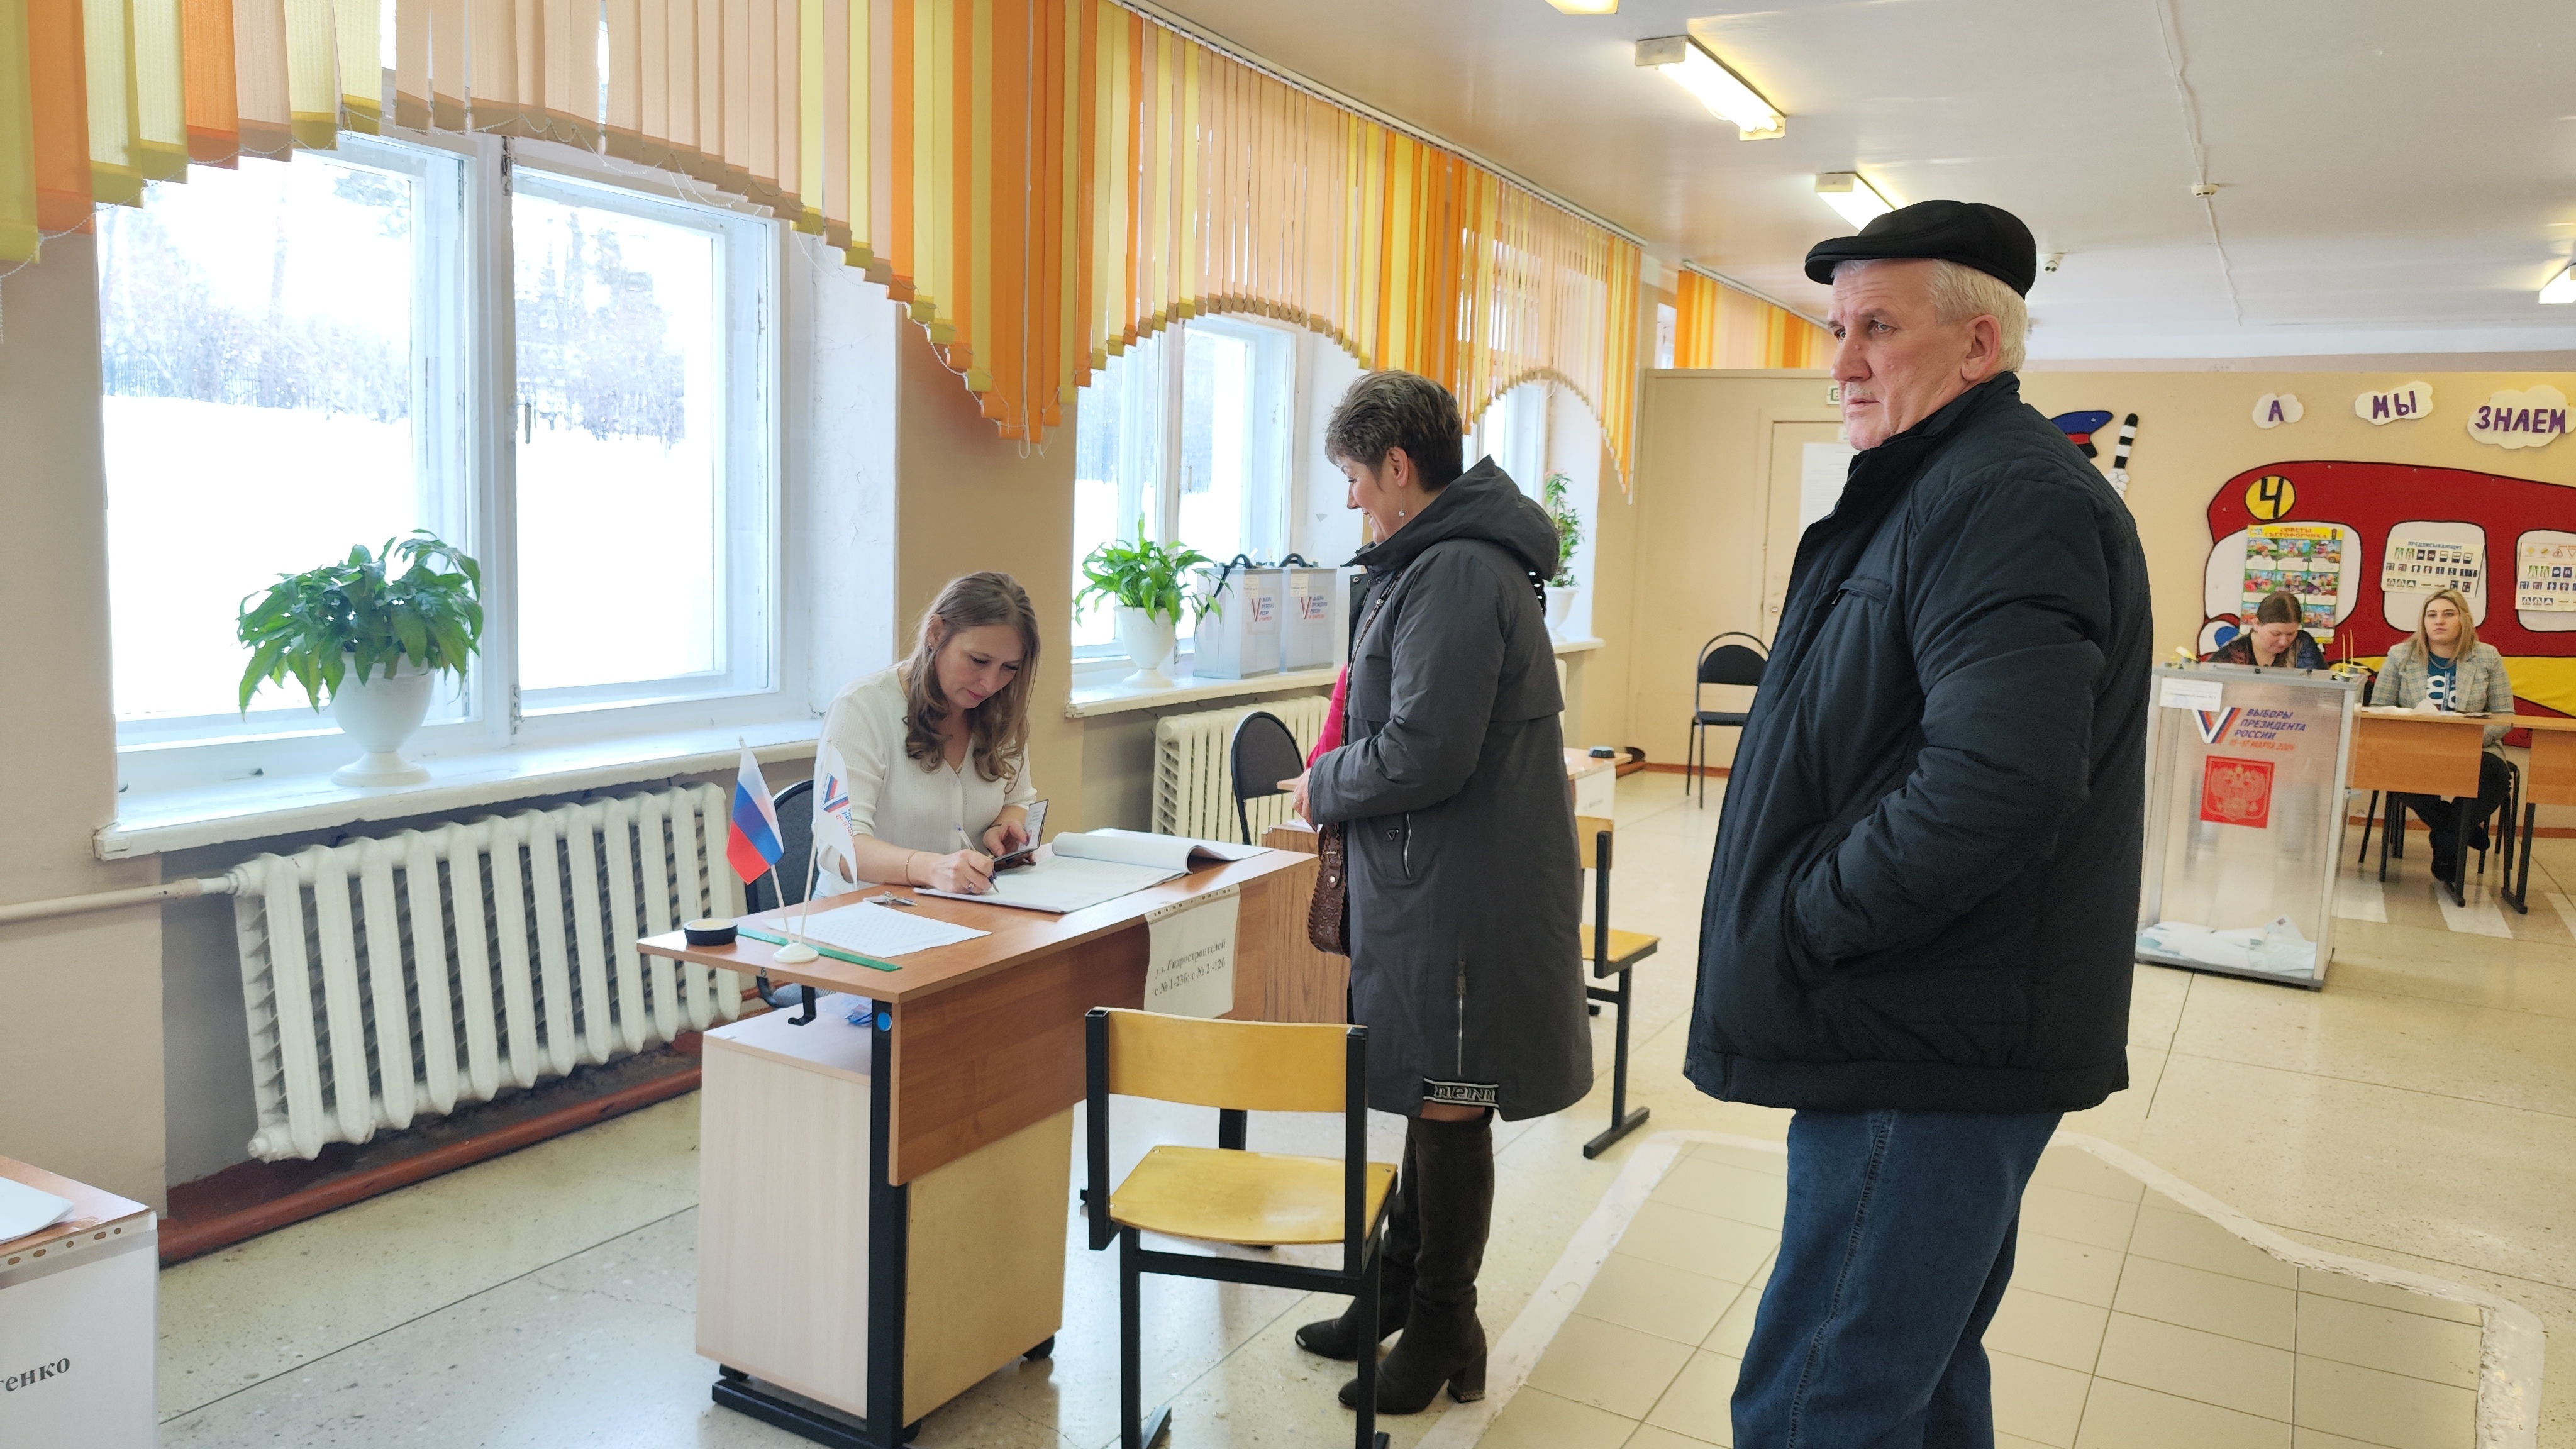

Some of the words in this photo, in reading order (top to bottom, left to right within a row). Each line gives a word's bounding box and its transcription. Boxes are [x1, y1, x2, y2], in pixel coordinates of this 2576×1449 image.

[2268, 400, 2284, 421] А
[2373, 390, 2417, 419] МЫ
[2475, 406, 2567, 434] ЗНАЕМ
[2407, 541, 2462, 550] ПРЕДПИСЫВАЮЩИЕ
[2246, 708, 2294, 719] ВЫБОРЫ
[2240, 719, 2306, 731] ПРЕЗИДЕНТА
[2234, 729, 2277, 740] РОССИИ
[1167, 939, 1226, 971] Гидростроителей
[0, 1358, 70, 1392] енко
